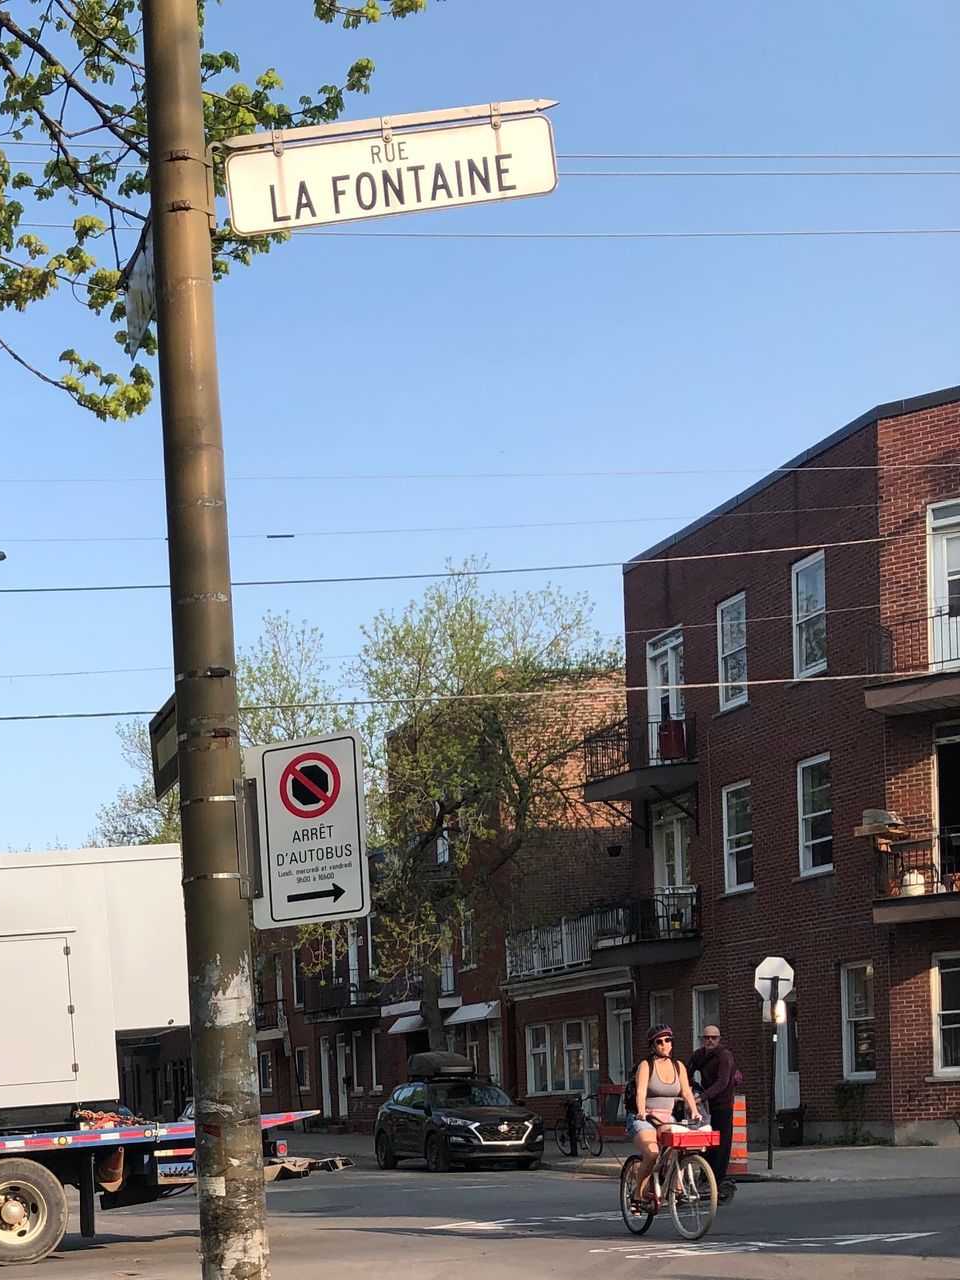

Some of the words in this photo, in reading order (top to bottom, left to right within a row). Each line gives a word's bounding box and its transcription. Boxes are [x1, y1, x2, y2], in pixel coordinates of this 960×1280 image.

[370, 141, 409, 164] RUE
[269, 181, 318, 222] LA
[331, 153, 517, 214] FONTAINE
[292, 823, 334, 843] ARRÊT
[276, 843, 352, 866] D'AUTOBUS
[296, 866, 319, 875] mercredi
[329, 861, 352, 870] vendredi
[296, 875, 311, 884] 9h00
[312, 874, 317, 882] à
[318, 872, 335, 881] 16h00
